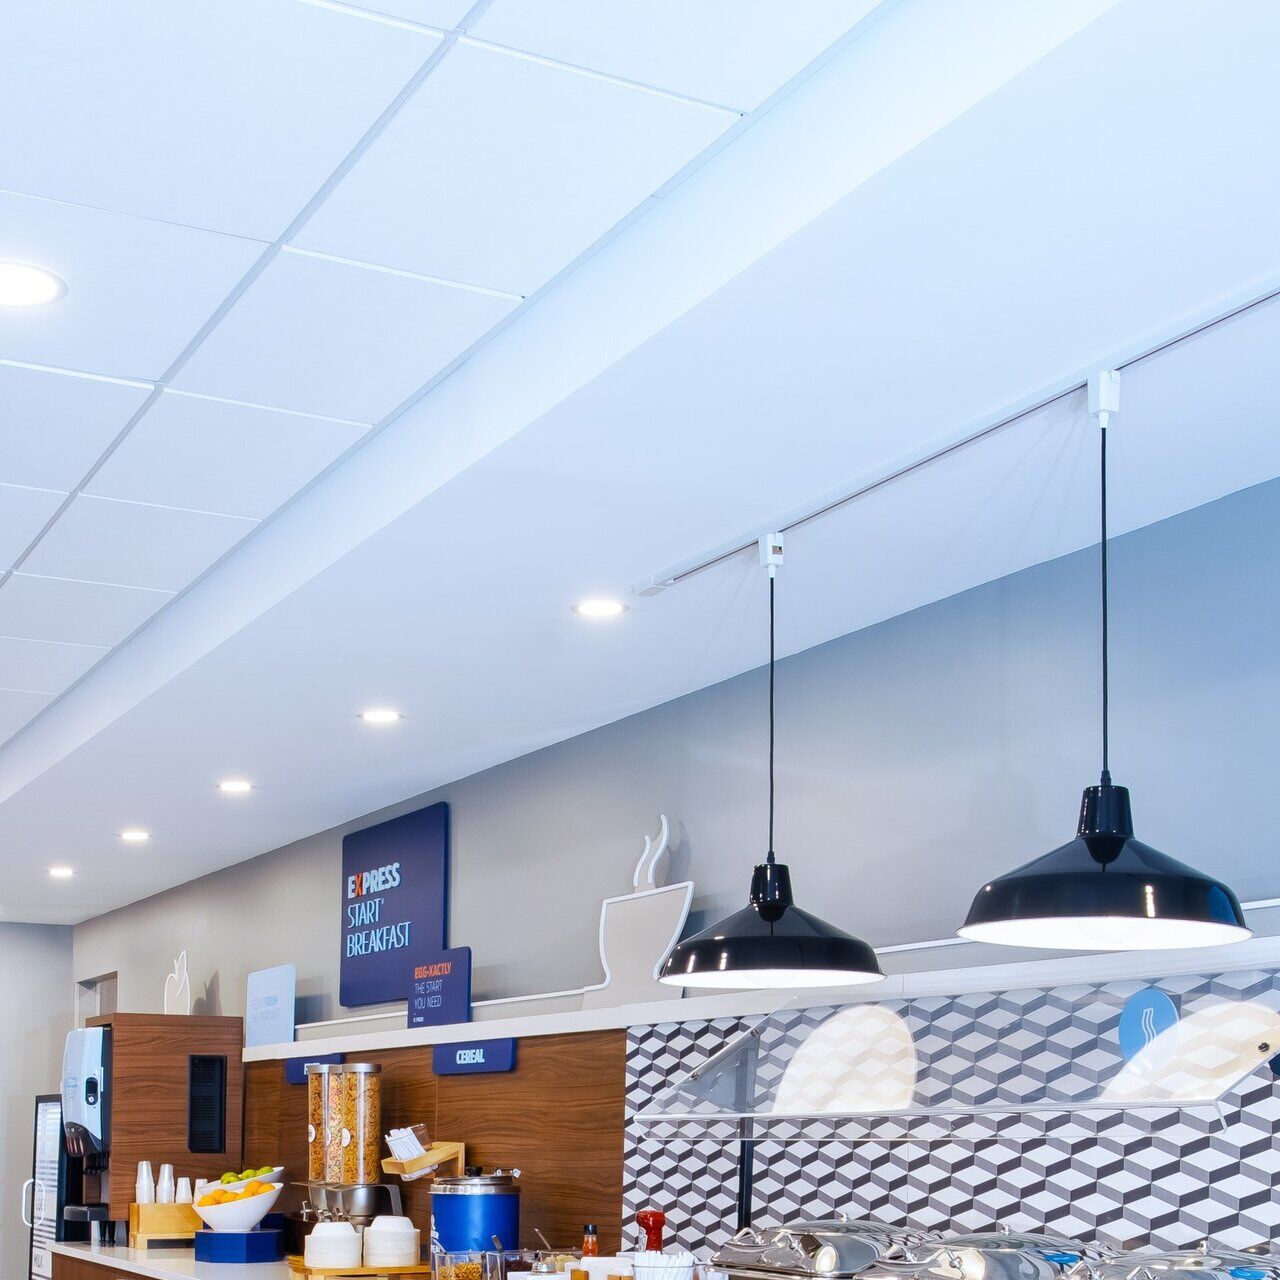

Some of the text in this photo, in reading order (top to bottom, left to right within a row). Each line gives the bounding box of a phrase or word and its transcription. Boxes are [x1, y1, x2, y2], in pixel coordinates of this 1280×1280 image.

[347, 861, 401, 899] EXPRESS
[346, 921, 412, 958] BREAKFAST
[414, 979, 443, 994] THE START
[414, 994, 443, 1010] YOU NEED
[456, 1048, 485, 1065] CEREAL
